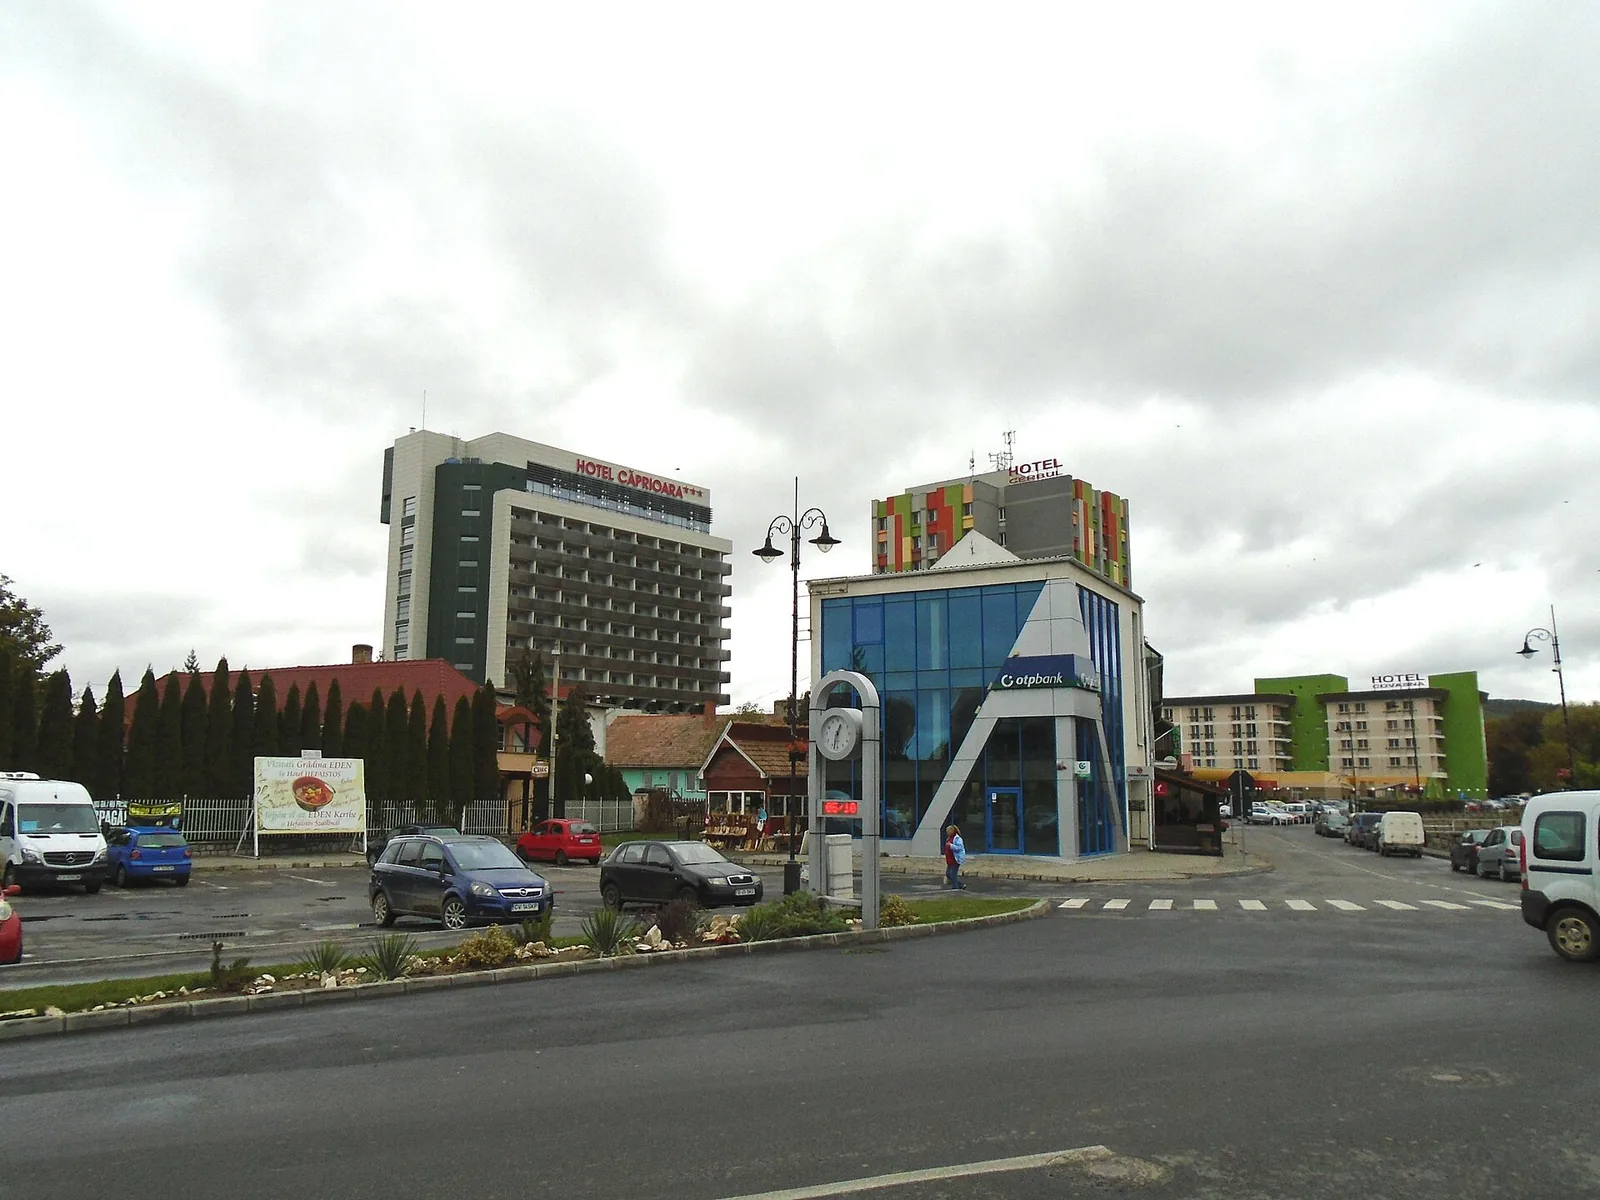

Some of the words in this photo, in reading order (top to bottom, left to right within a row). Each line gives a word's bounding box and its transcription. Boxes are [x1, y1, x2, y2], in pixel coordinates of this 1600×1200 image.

[1008, 458, 1063, 476] HOTEL
[576, 458, 614, 481] HOTEL
[617, 469, 684, 499] CĂPRIOARA
[1008, 471, 1063, 484] CERBUL
[1015, 672, 1063, 688] otpbank
[1371, 673, 1425, 683] HOTEL
[329, 761, 352, 769] EDEN
